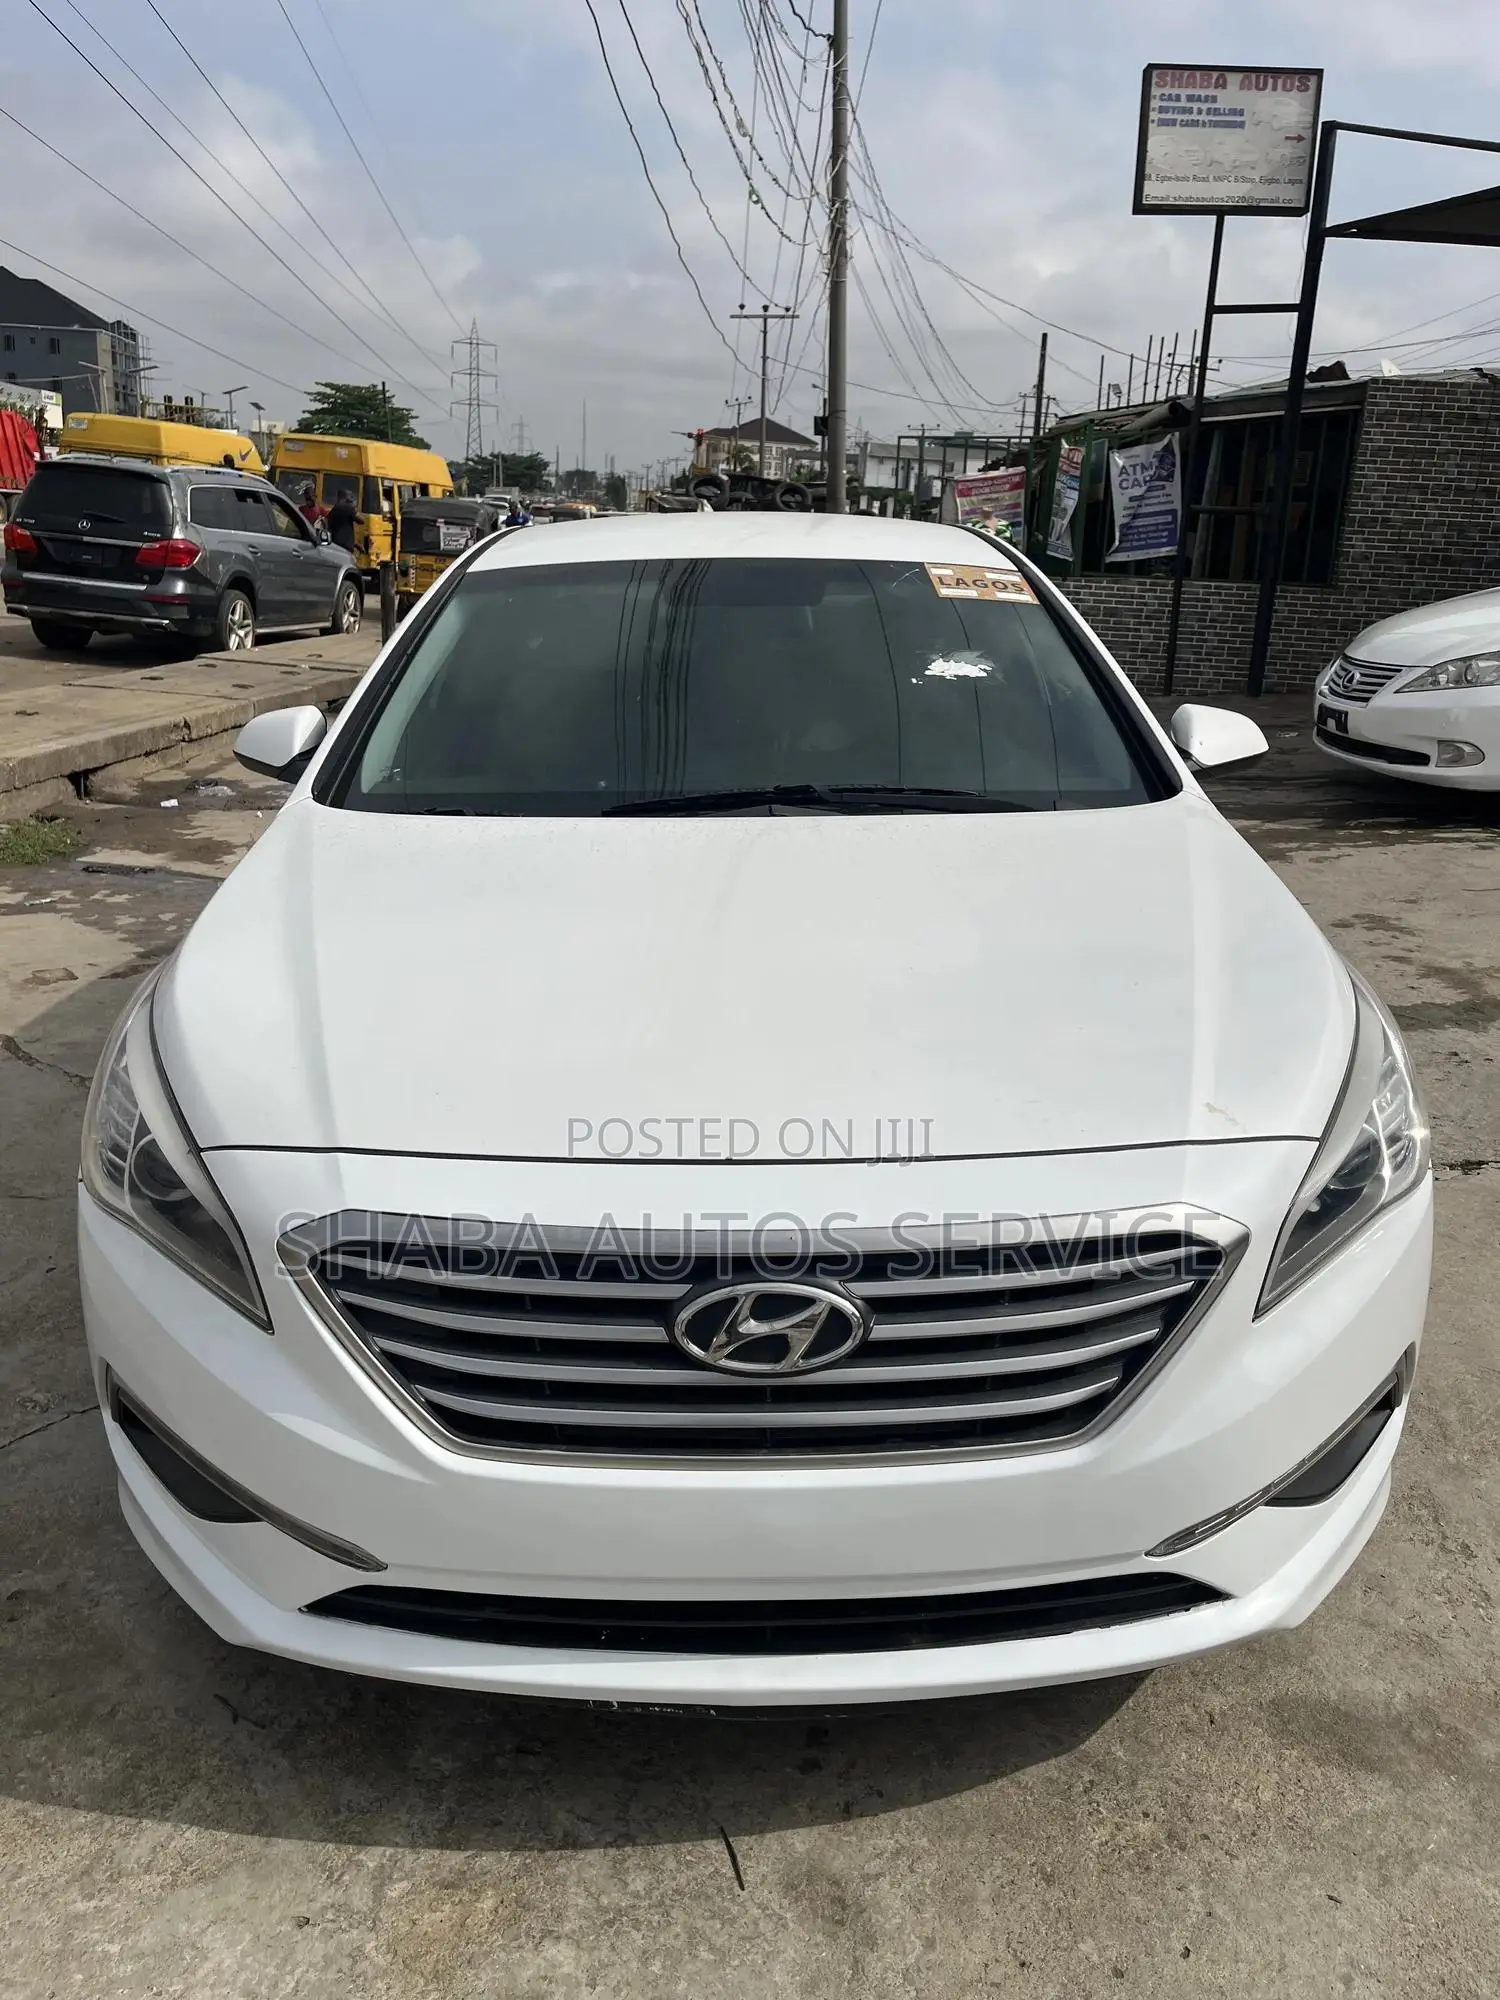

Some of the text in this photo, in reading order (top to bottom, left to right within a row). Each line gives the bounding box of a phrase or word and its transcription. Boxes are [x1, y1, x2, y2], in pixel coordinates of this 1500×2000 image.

[1154, 70, 1312, 92] SHABA AUTOS
[1158, 92, 1218, 104] CAR WASH
[1158, 105, 1194, 115] BUYING
[1205, 107, 1245, 117] SELLING
[1118, 462, 1154, 477] ATM
[937, 576, 1025, 592] LAGOS
